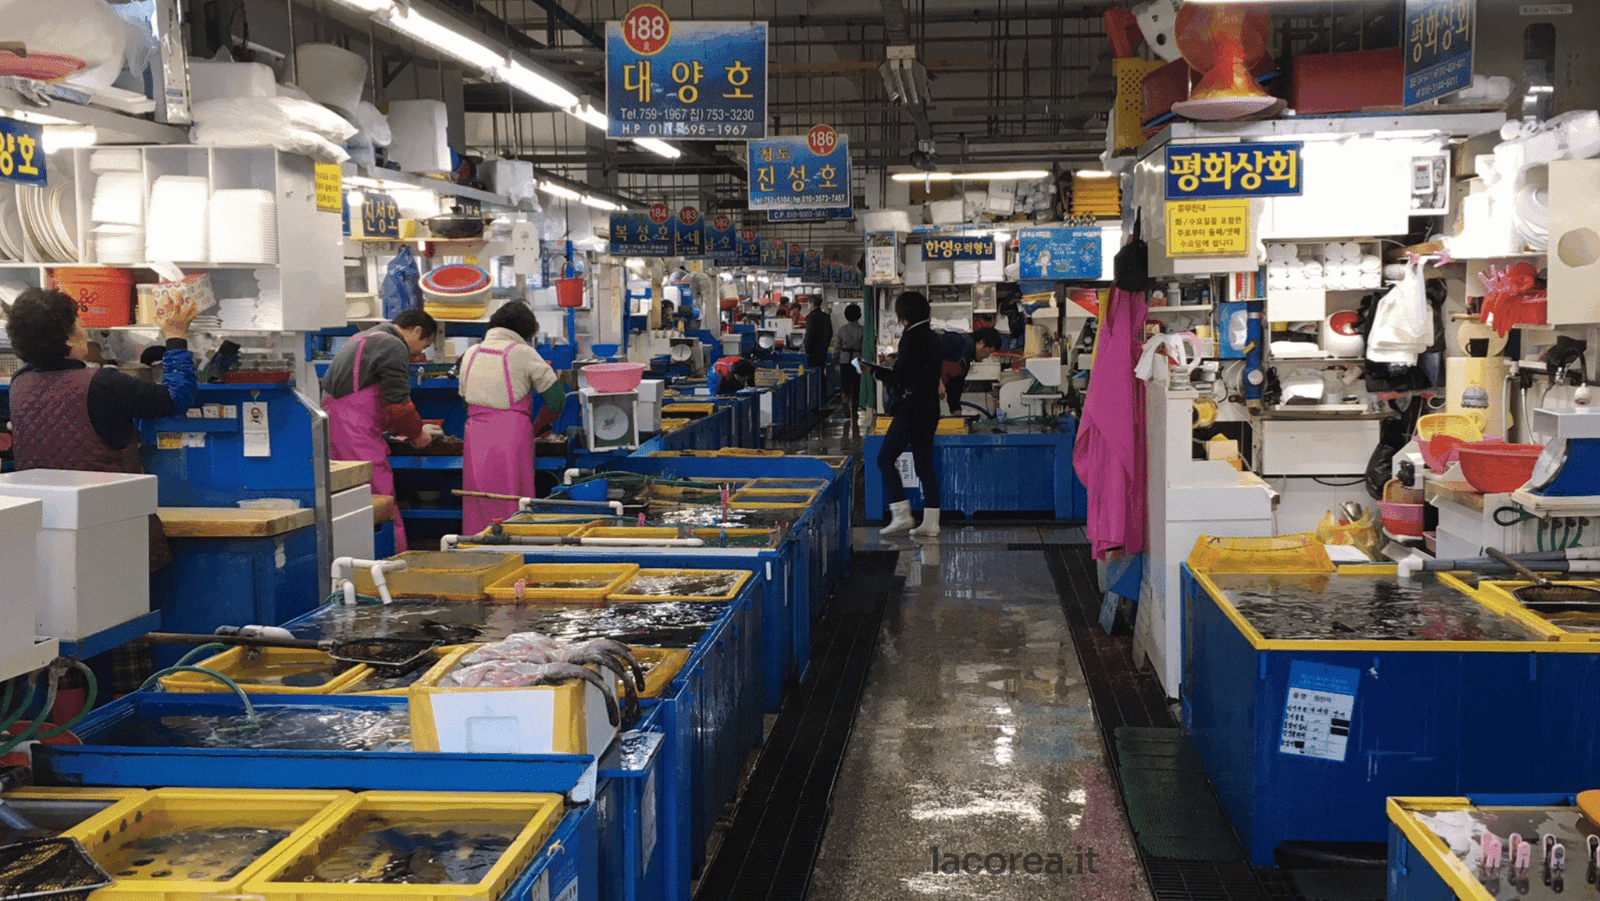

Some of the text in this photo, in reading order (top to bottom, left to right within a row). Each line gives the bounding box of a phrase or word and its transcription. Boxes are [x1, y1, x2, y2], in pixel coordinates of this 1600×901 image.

[628, 15, 665, 41] 188
[1411, 1, 1469, 62] 평화상회
[620, 108, 686, 120] Tel.759-1967
[706, 108, 754, 121] 753-3230
[622, 124, 641, 134] H.P
[809, 131, 835, 147] 186
[1169, 150, 1296, 192] 평화상회
[363, 198, 399, 234] 진성호
[651, 209, 667, 218] 184
[682, 210, 696, 219] 183
